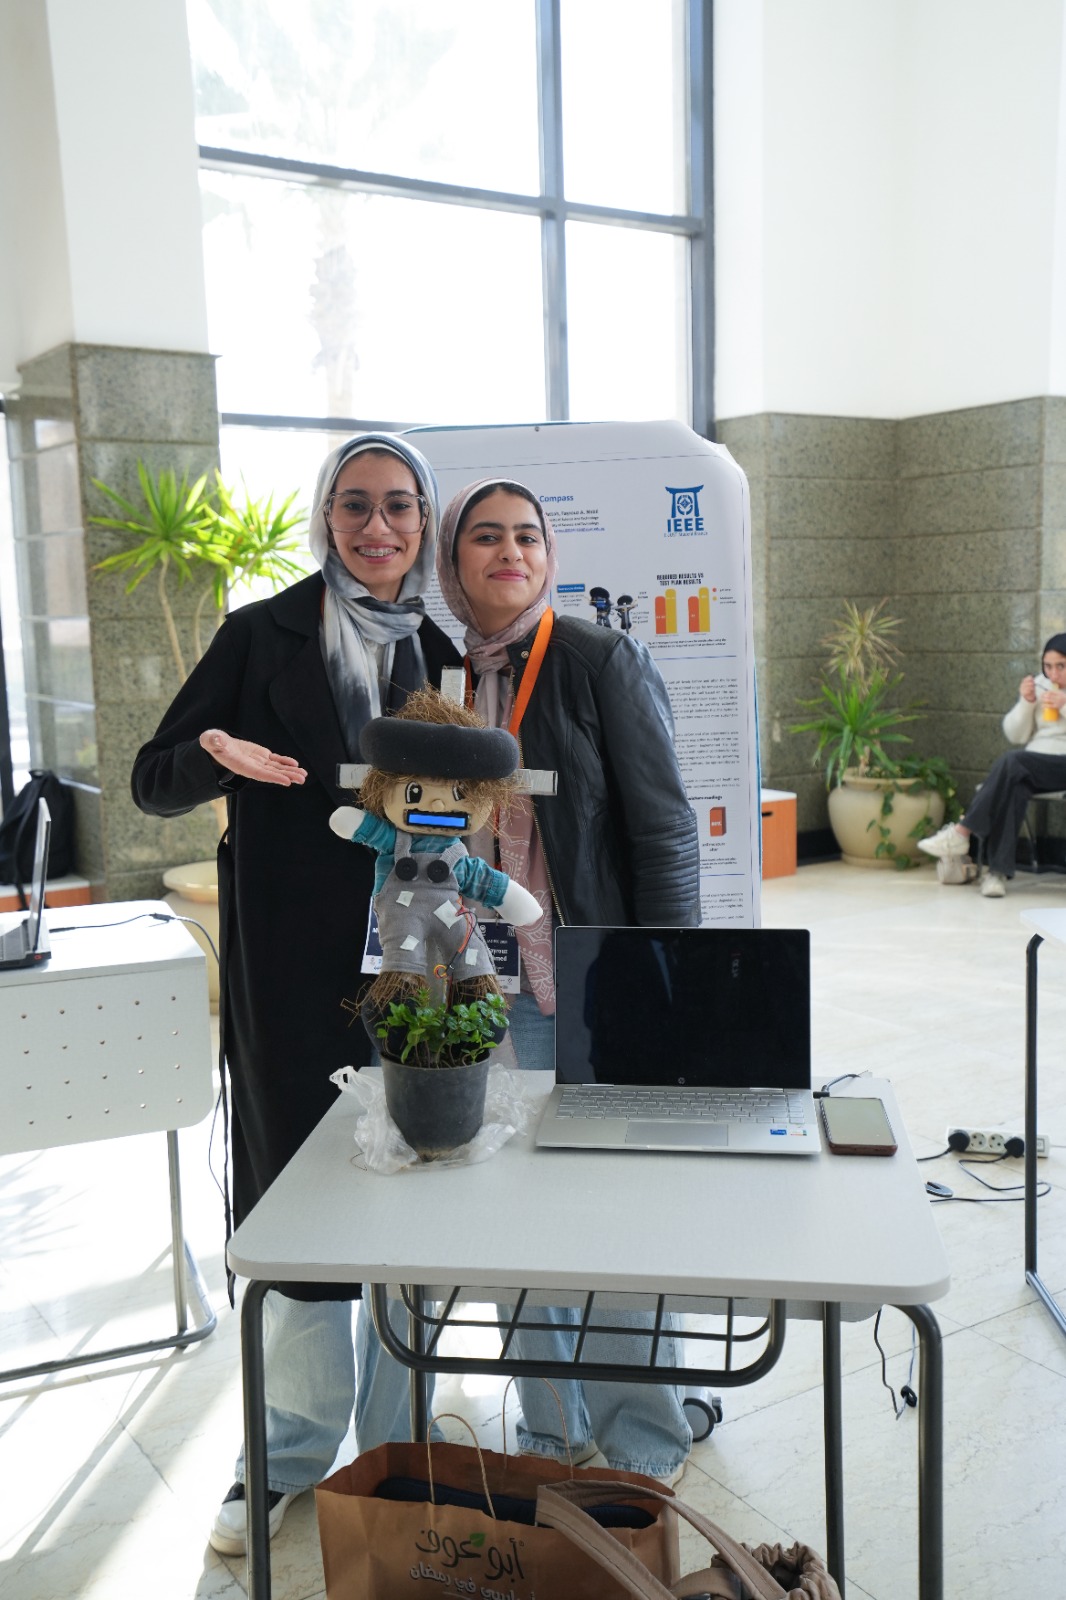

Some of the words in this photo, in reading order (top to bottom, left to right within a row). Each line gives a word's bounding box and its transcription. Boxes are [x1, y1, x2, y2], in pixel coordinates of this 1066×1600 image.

[539, 495, 574, 503] Compass
[667, 517, 704, 532] IEEE
[415, 1529, 482, 1568] عوف
[485, 1537, 525, 1583] أبو
[410, 1560, 451, 1586] رمضان
[454, 1576, 477, 1594] في
